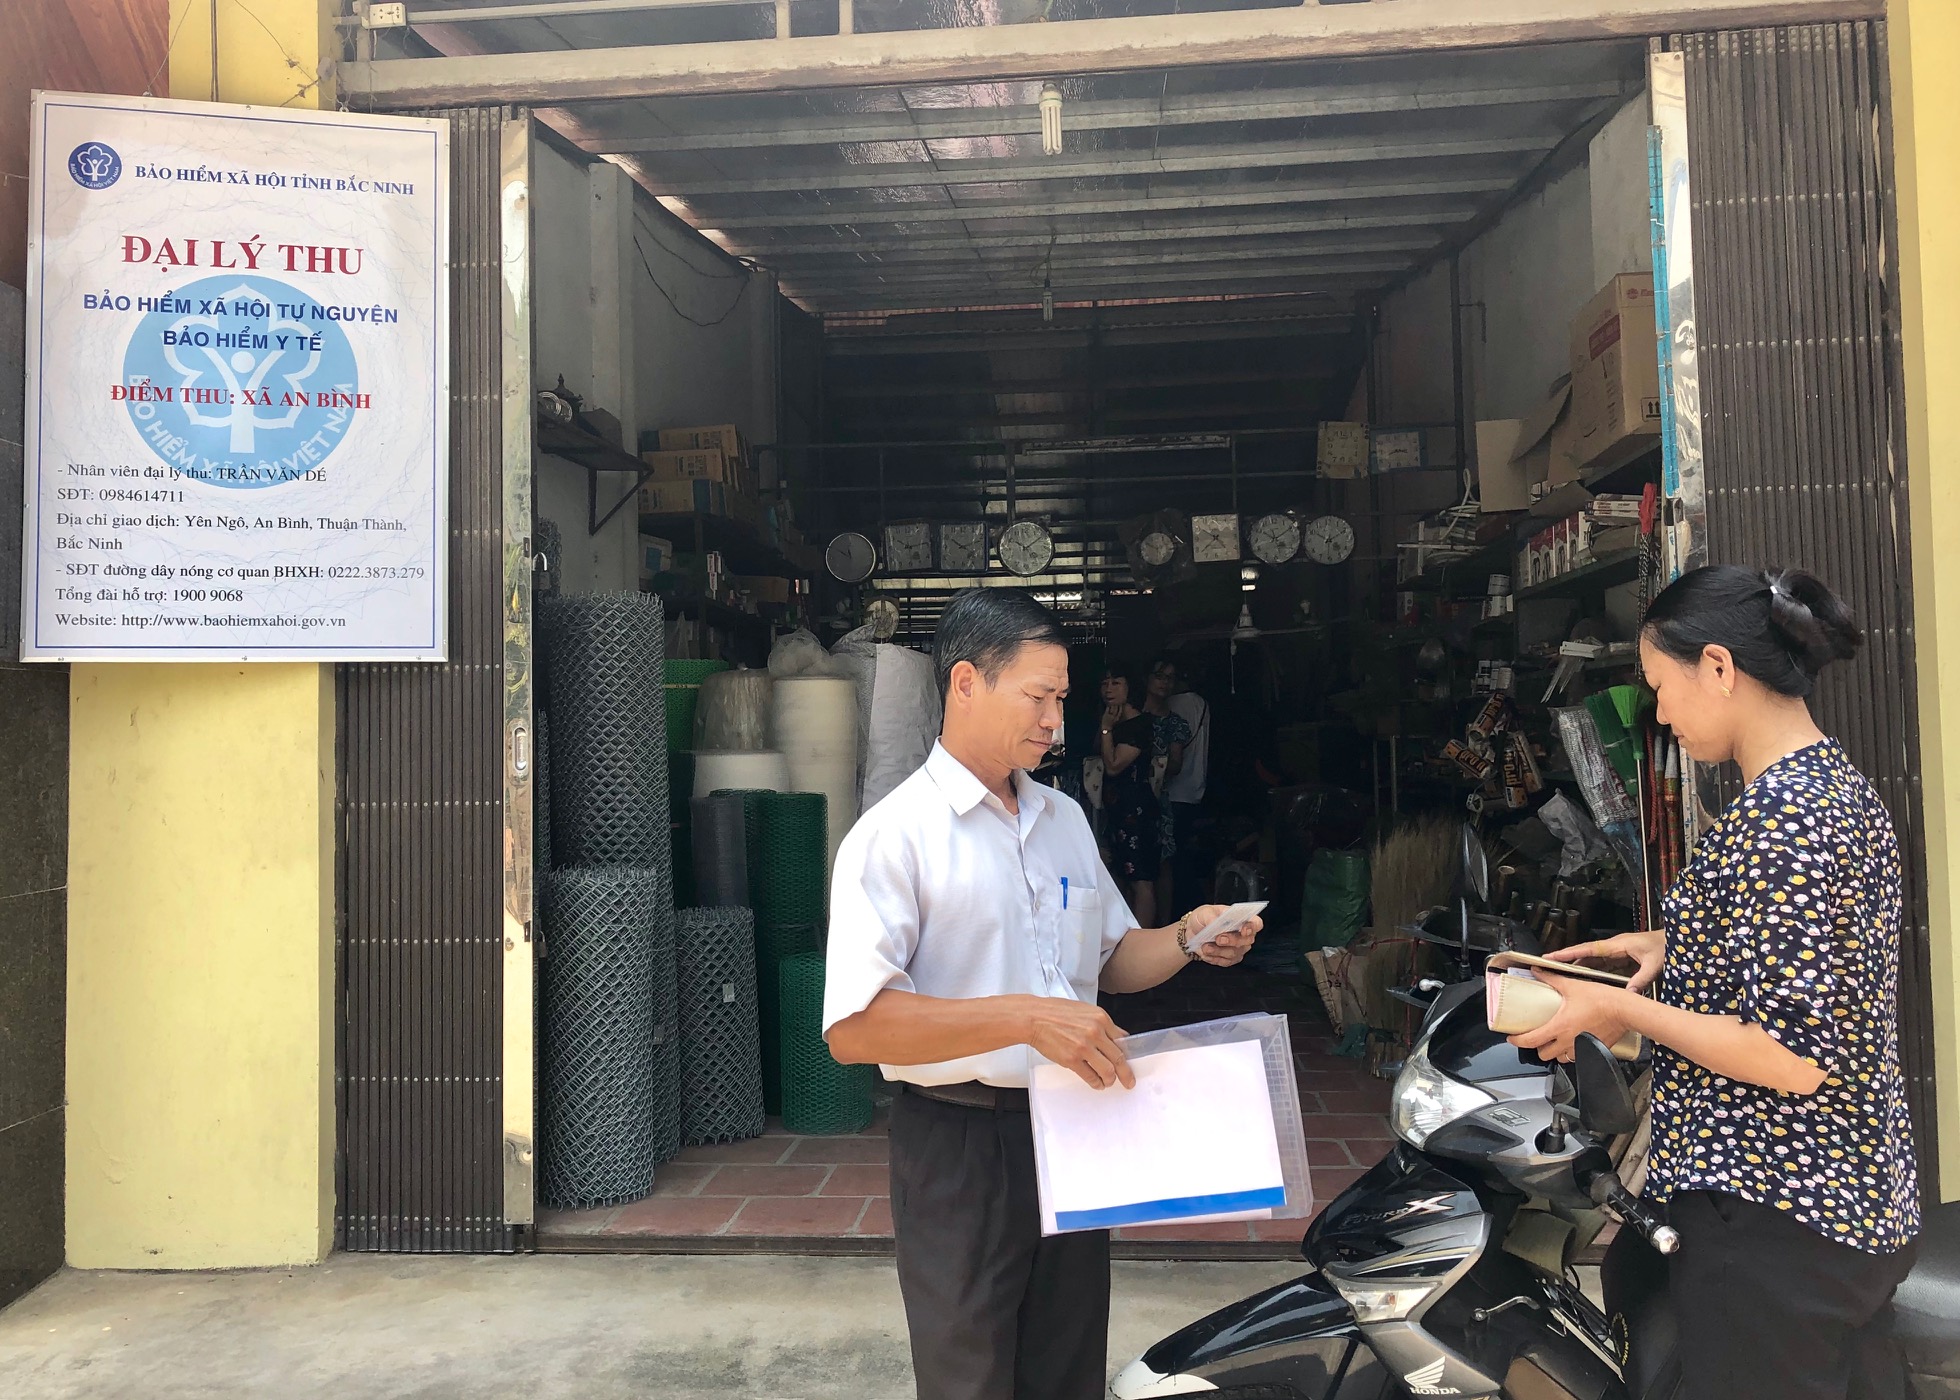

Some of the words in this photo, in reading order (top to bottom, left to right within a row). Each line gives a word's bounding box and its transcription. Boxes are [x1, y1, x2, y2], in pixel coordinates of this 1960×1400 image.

[135, 163, 171, 180] BẢO
[177, 165, 222, 183] HIỂM
[227, 170, 250, 185] XÃ
[255, 172, 286, 189] HỘI
[291, 174, 331, 190] TỈNH
[336, 175, 369, 192] BẮC
[373, 181, 414, 195] NINH
[121, 235, 199, 273] ĐẠI
[210, 234, 267, 270] LÝ
[278, 244, 364, 275] THU
[84, 289, 131, 311] BẢO
[138, 290, 191, 314] HIỂM
[199, 297, 228, 316] XÃ
[235, 299, 271, 320] HỘI
[277, 303, 306, 322] TỰ
[312, 304, 398, 326] NGUYỆN
[163, 325, 210, 347] BẢO
[216, 325, 268, 349] HIỂM
[276, 335, 288, 350] Y
[296, 330, 322, 351] TẾ
[110, 378, 173, 403] ĐIỂM
[180, 388, 235, 405] THU:
[241, 386, 273, 406] XÃ
[279, 391, 310, 407] AN
[316, 390, 372, 409] BÌNH
[67, 464, 105, 477] Nhân
[110, 465, 139, 478] viên
[143, 466, 164, 481] đại
[169, 467, 182, 481] lý
[186, 468, 212, 480] thu:
[216, 463, 261, 480] TRẦN
[266, 466, 301, 481] VĂN
[305, 467, 327, 482] DÉ
[57, 488, 94, 501] SĐT:
[98, 489, 184, 502] 0984614711
[56, 512, 82, 528] Địa
[86, 513, 108, 526] chỉ
[112, 515, 142, 529] giao
[145, 515, 180, 529] dịch:
[184, 515, 212, 528] Yên
[216, 516, 249, 531] Ngô,
[253, 517, 273, 529] An
[277, 516, 313, 531] Bình,
[317, 517, 358, 532] Thuận
[362, 518, 407, 532] Thành,
[56, 535, 83, 550] Bắc
[88, 537, 123, 550] Ninh
[65, 563, 100, 576] SĐT
[103, 564, 147, 579] đường
[151, 564, 176, 579] dây
[180, 565, 214, 580] nóng
[217, 566, 234, 577] cơ
[237, 568, 270, 580] quan
[273, 565, 324, 579] BHXH:
[328, 566, 425, 579] 0222.3873.279
[55, 586, 92, 603] Tổng
[97, 588, 118, 601] đài
[122, 586, 140, 601] hỗ
[144, 590, 167, 603] trợ:
[173, 589, 206, 602] 1900
[210, 589, 243, 602] 9068
[55, 613, 117, 626] Website:
[121, 614, 346, 629] http://www.baohiemxahoi.gov.vn
[1409, 1387, 1462, 1395] HONDA
